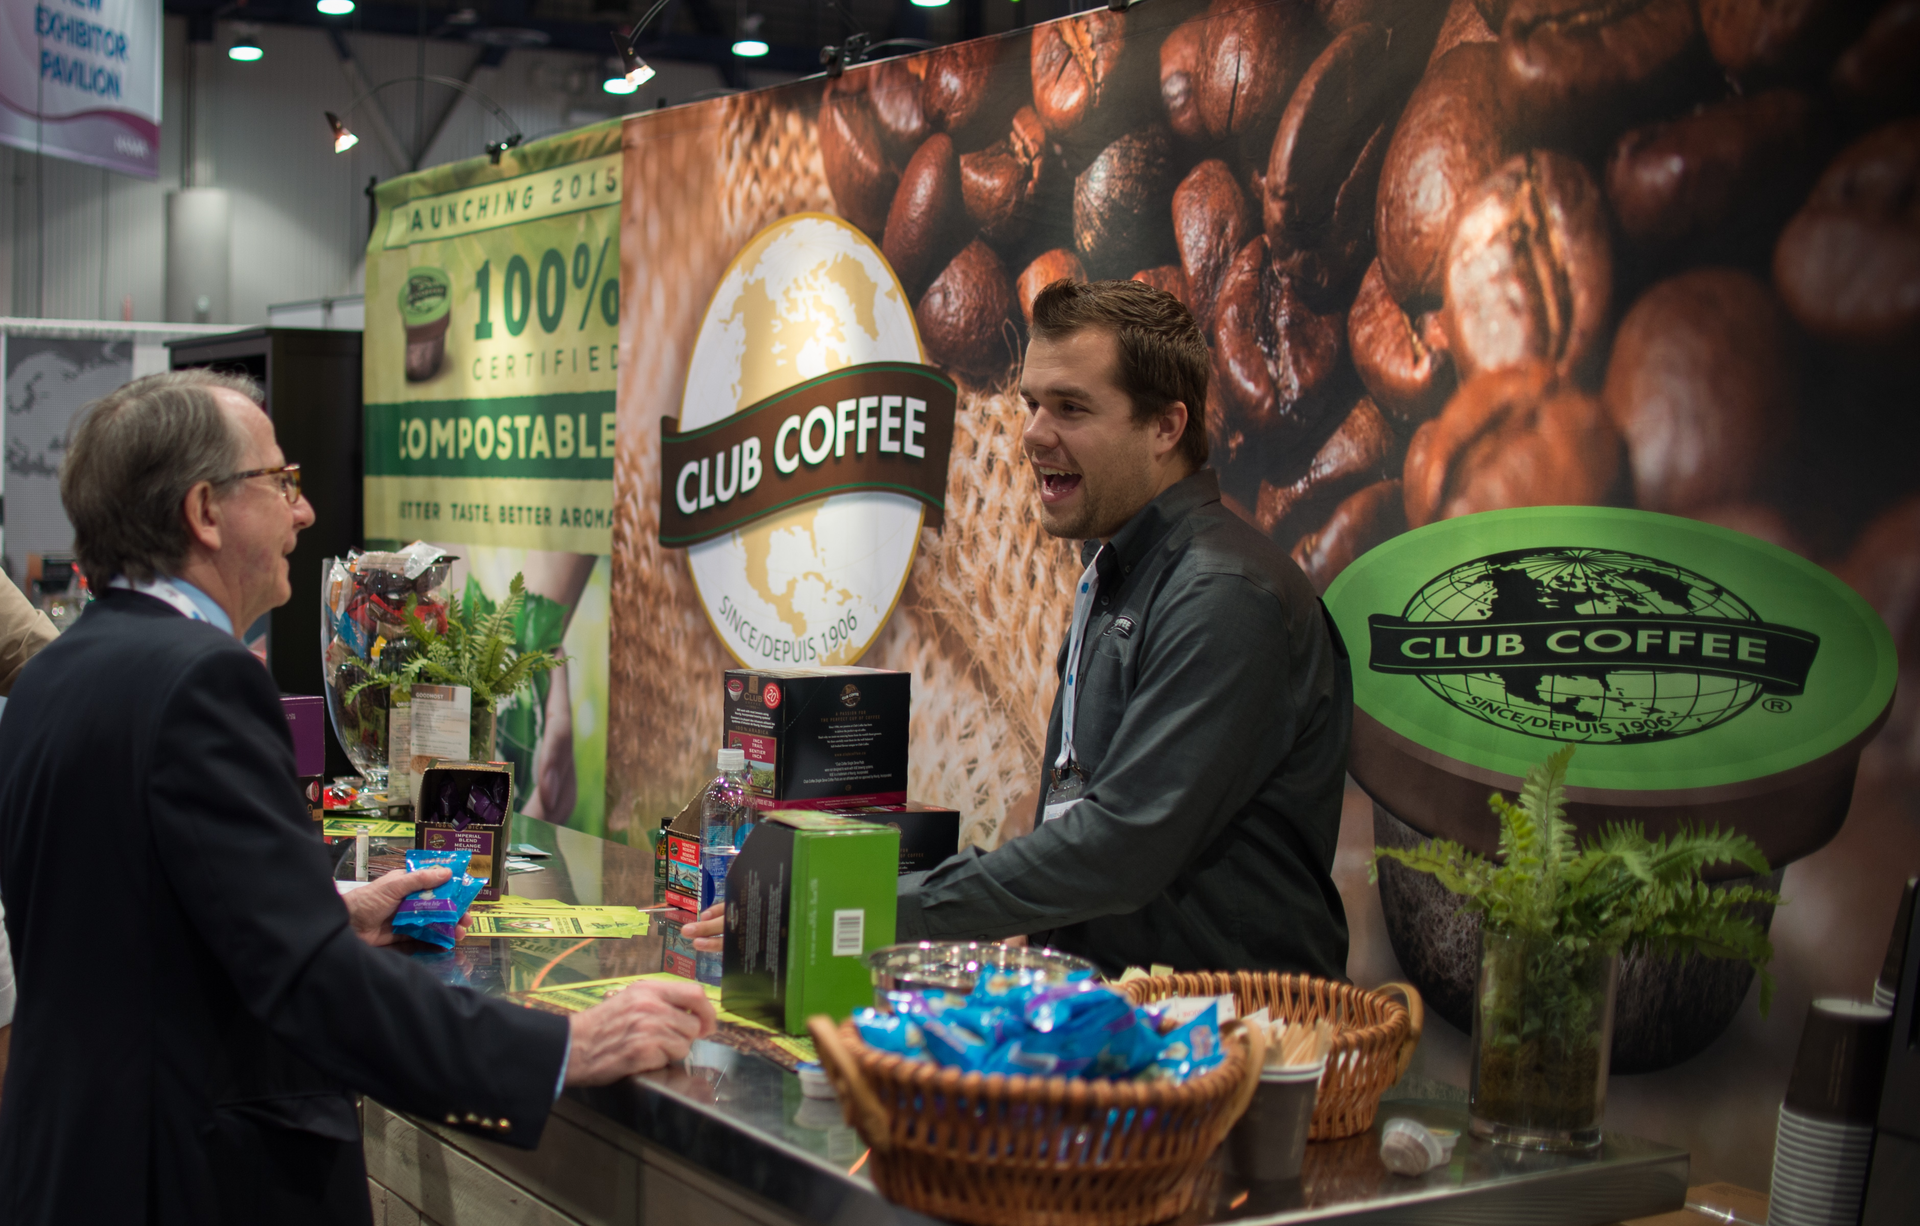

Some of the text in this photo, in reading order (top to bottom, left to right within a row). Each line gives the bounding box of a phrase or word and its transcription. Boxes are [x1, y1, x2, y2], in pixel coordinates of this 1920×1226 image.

[35, 5, 129, 62] EXHIBITOR
[40, 48, 122, 101] PAVILION
[411, 167, 618, 232] AUNCHING 2015
[474, 236, 620, 341] 100%
[472, 343, 618, 381] CERTIFIED
[675, 393, 928, 515] CLUB COFFEE
[400, 501, 441, 521] ETTER
[499, 505, 553, 527] BETTER
[559, 507, 615, 530] AROMA
[718, 594, 859, 664] SINCE/DEPUIS 1906
[1399, 628, 1768, 665] CLUB COFFEE
[1465, 694, 1613, 736] SINCE/DEPUIS
[1618, 714, 1674, 737] 1906
